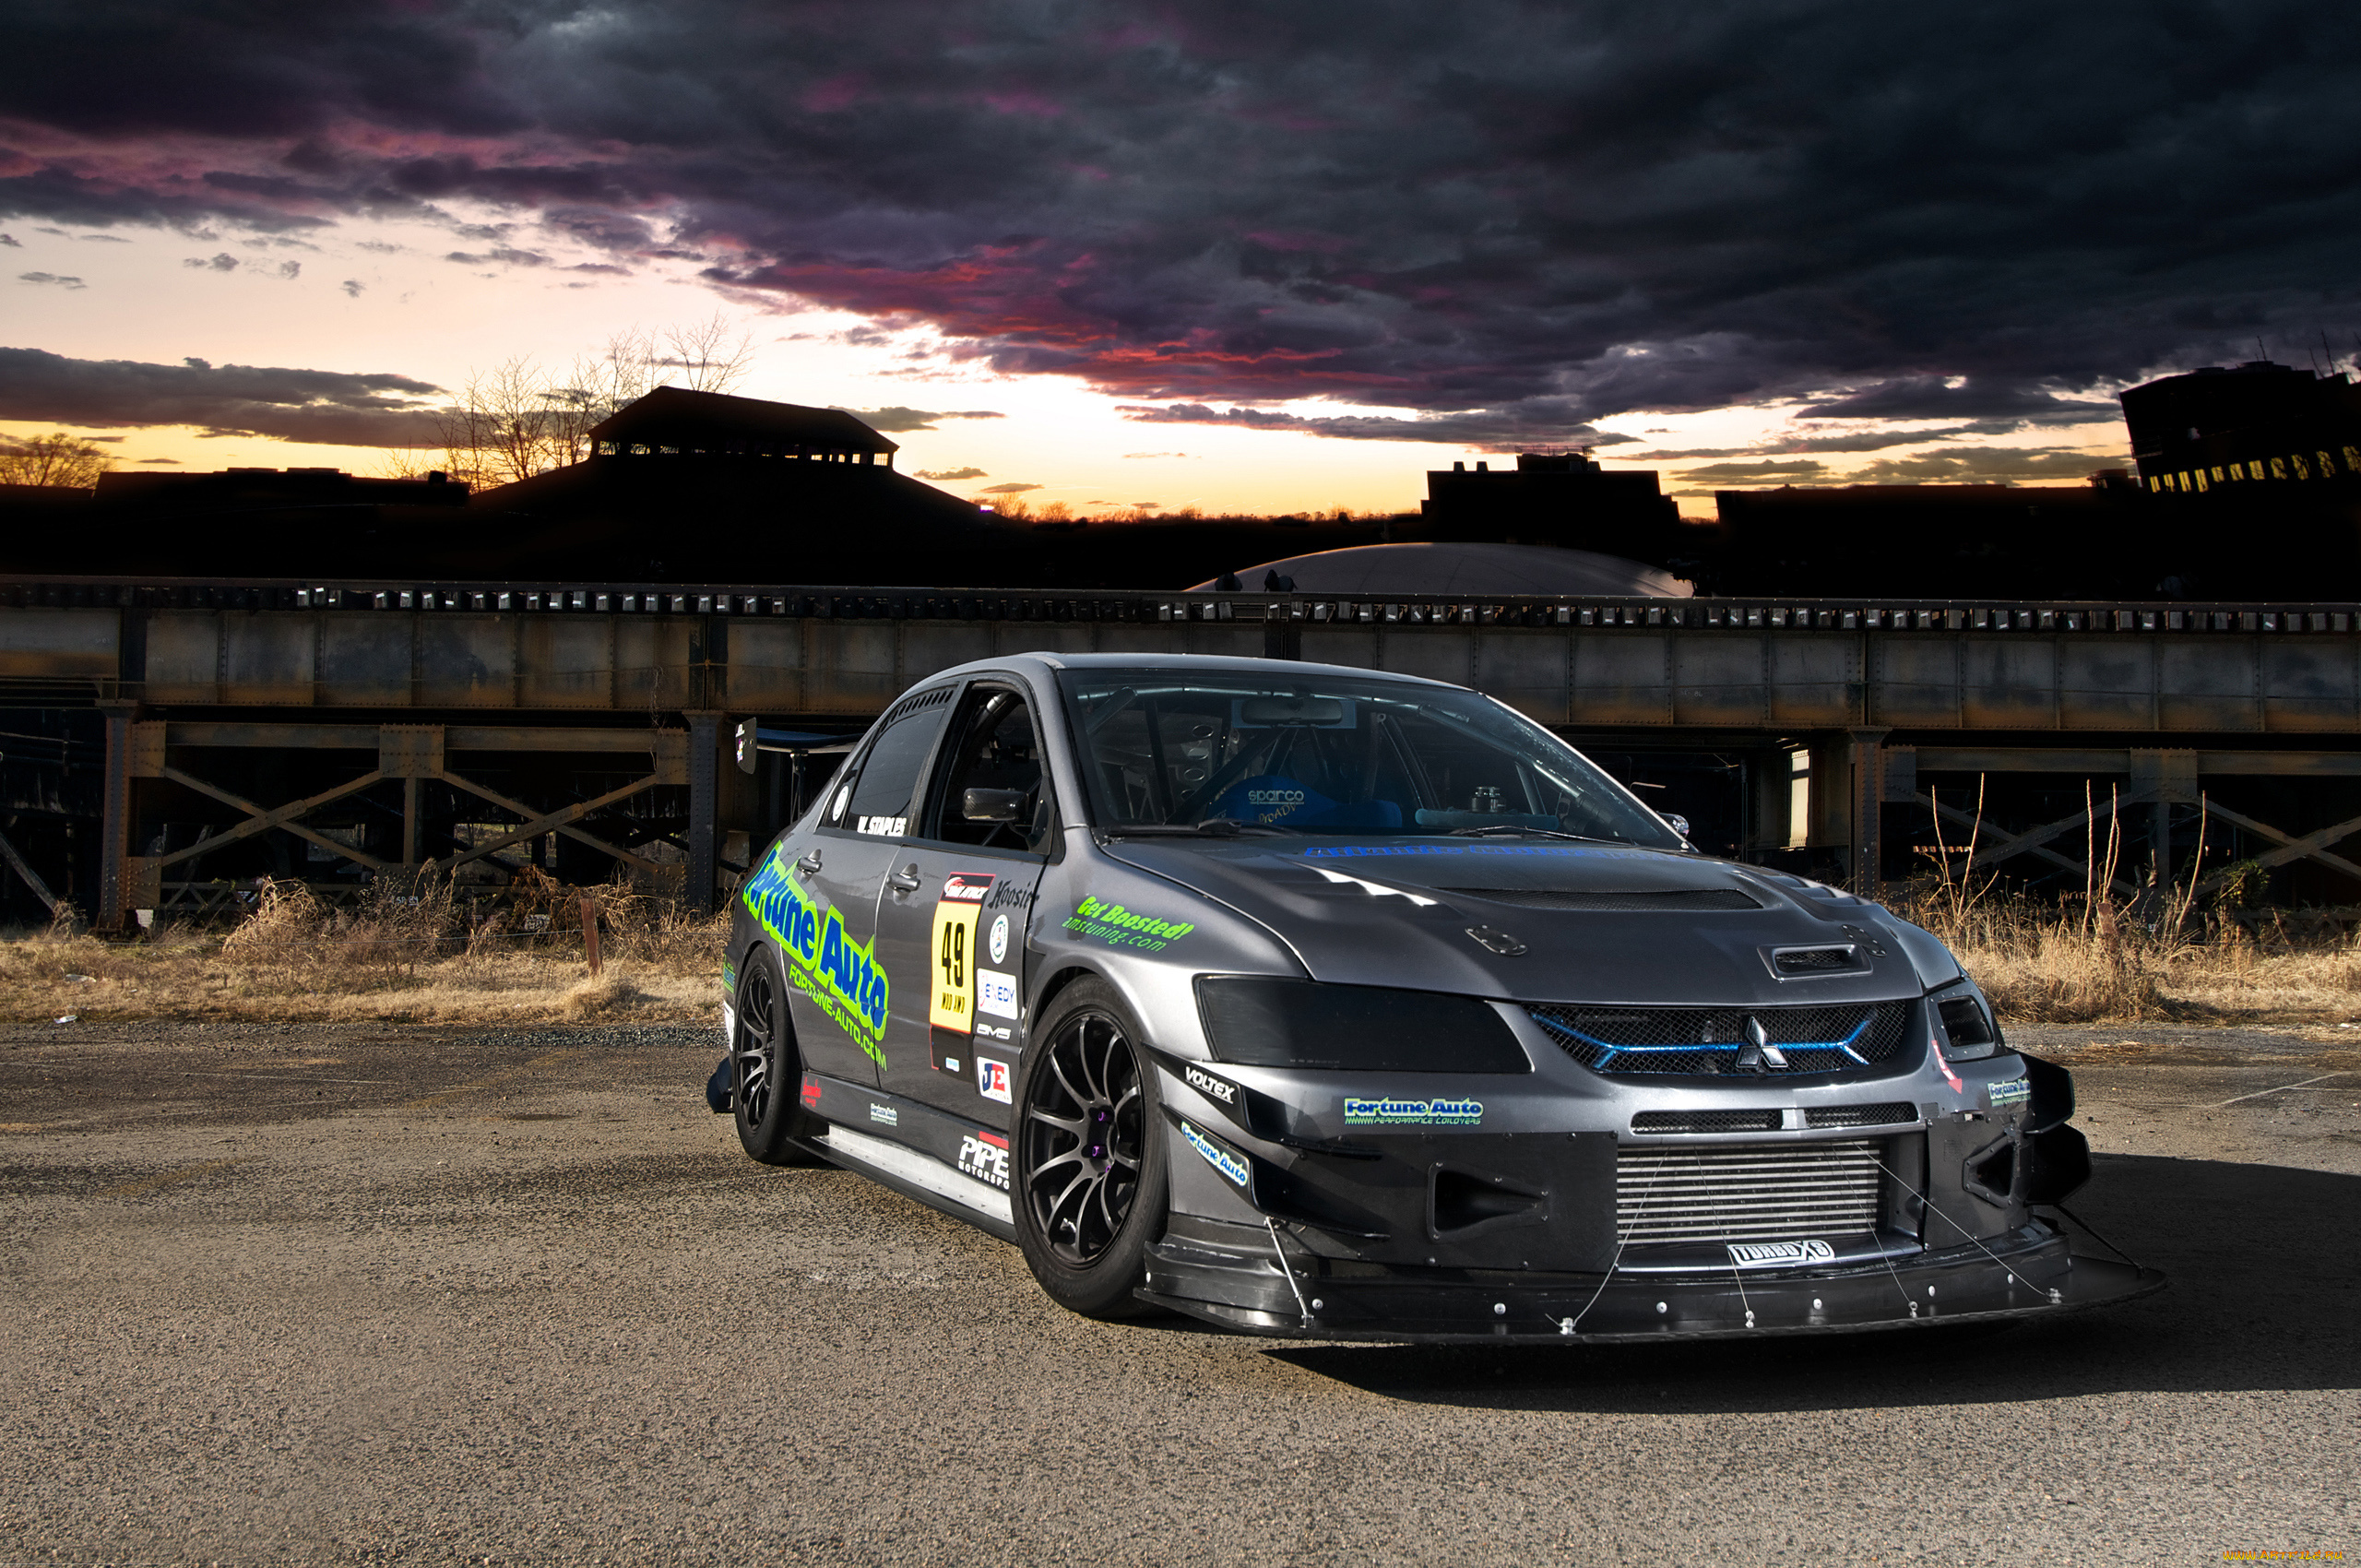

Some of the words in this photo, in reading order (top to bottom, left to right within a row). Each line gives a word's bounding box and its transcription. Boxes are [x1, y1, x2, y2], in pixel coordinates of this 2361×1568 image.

[1249, 790, 1304, 804] sparco
[867, 815, 908, 837] STAPLES
[1062, 916, 1167, 952] amstuning.com
[1076, 896, 1110, 919] Get
[1099, 904, 1194, 941] Boosted!
[742, 839, 819, 970] Fortune
[814, 904, 890, 1040] Auto
[941, 921, 965, 988] 49
[985, 983, 1014, 1004] EXEDY
[982, 1063, 1005, 1092] JE
[1184, 1065, 1236, 1101] VOLTEX
[1345, 1095, 1430, 1117] Fortune
[1429, 1095, 1484, 1117] Auto
[1374, 1116, 1433, 1124] PERFORMANCE
[1435, 1116, 1481, 1125] COILOVERS
[959, 1134, 1009, 1179] PIPE
[1181, 1121, 1219, 1164] Fortune
[1218, 1151, 1248, 1187] Auto
[958, 1159, 1010, 1190] MOTORSPO
